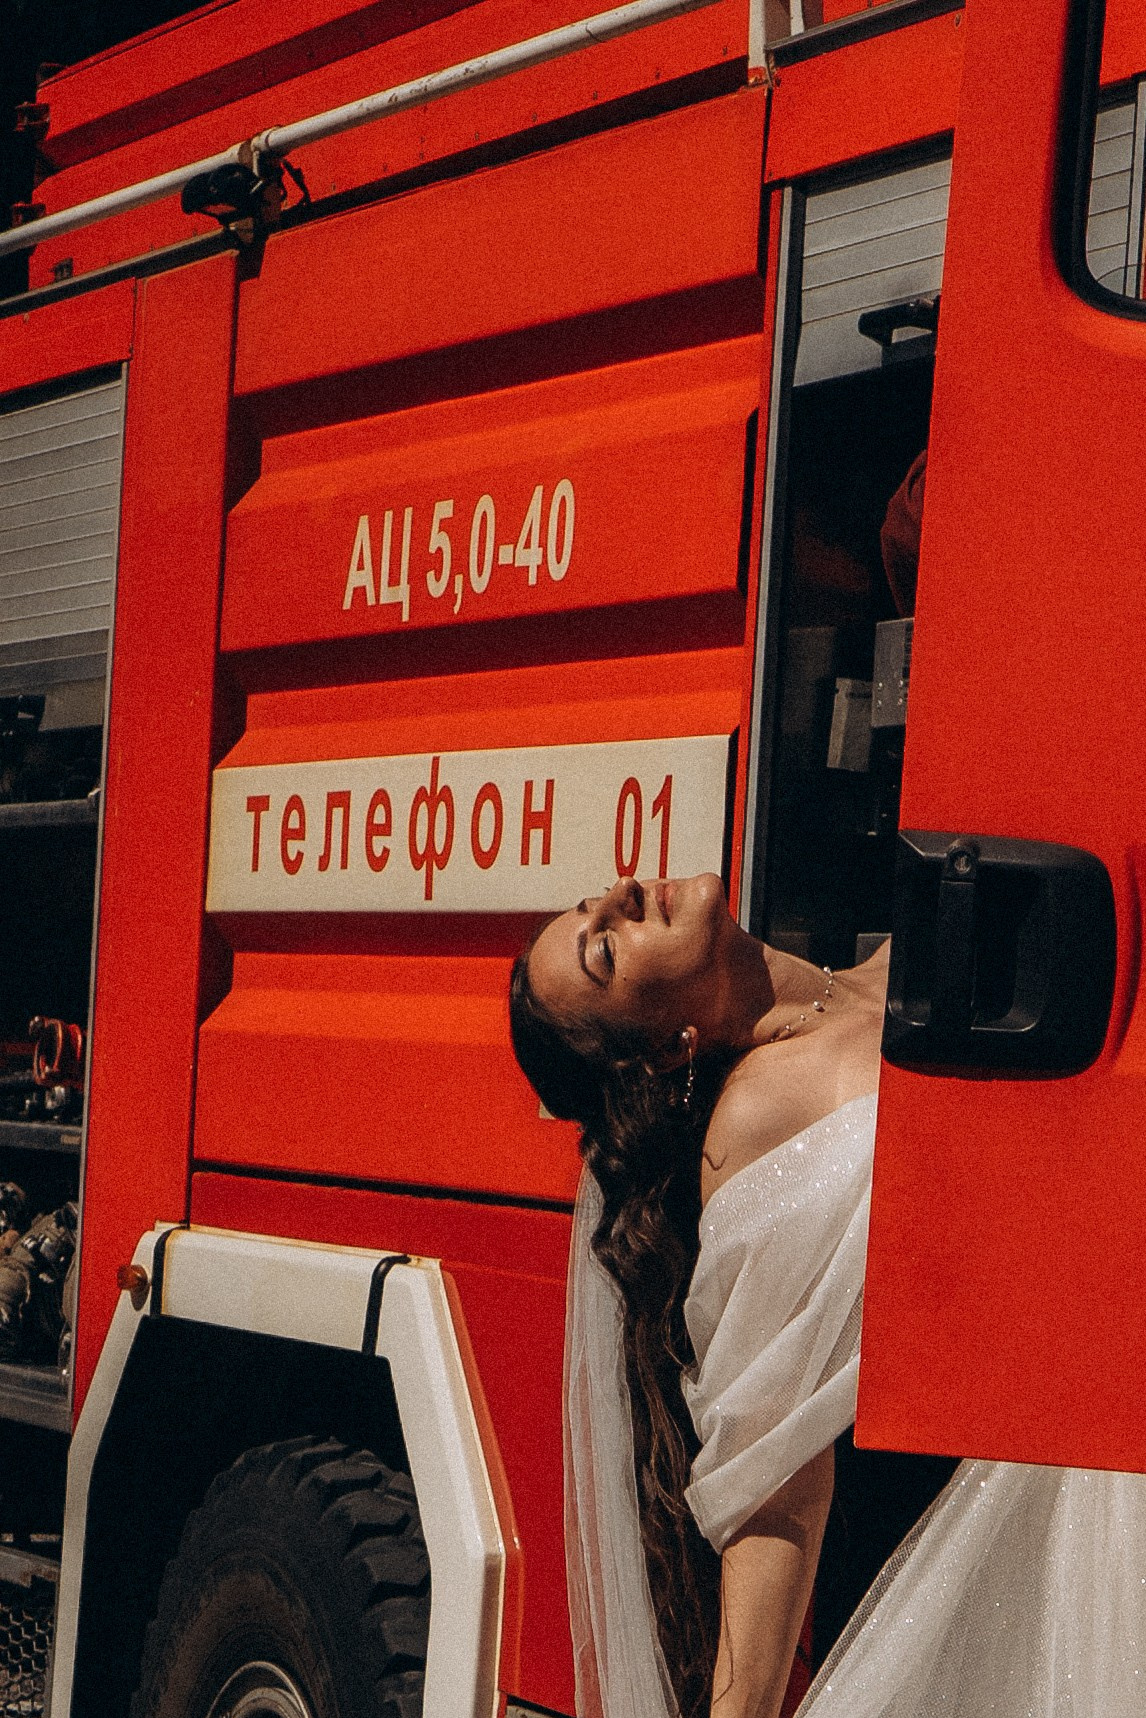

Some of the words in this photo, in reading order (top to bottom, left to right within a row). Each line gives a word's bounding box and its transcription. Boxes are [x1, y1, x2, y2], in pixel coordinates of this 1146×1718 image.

[342, 507, 412, 622] АЦ
[426, 479, 575, 614] 5,0-40
[246, 757, 555, 901] телефон
[614, 775, 674, 879] 01
